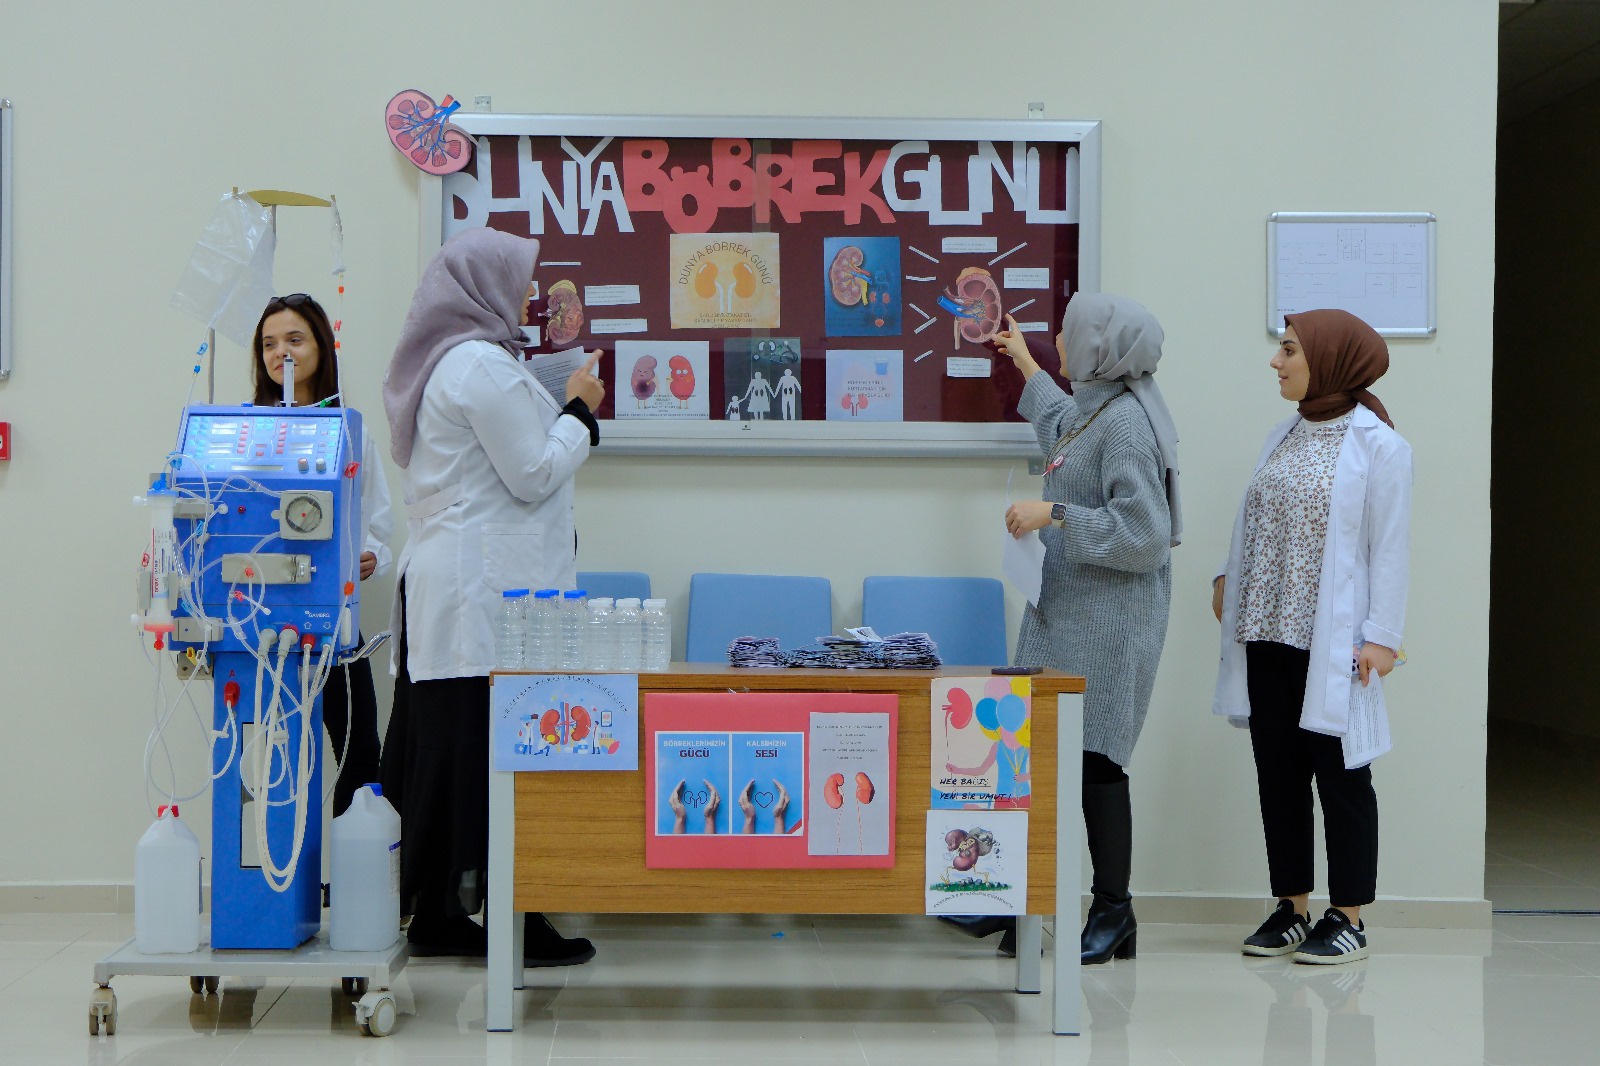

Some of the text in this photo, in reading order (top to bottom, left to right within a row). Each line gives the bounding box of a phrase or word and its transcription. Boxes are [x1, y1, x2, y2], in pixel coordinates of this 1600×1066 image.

[622, 138, 896, 234] BÖBREK
[705, 240, 751, 257] BÖBREK
[750, 254, 774, 285] GÜNÜ
[746, 739, 787, 747] KALBİMİZİN
[679, 747, 710, 758] GÜCÜ
[755, 748, 778, 758] SESİ
[940, 777, 957, 785] HER
